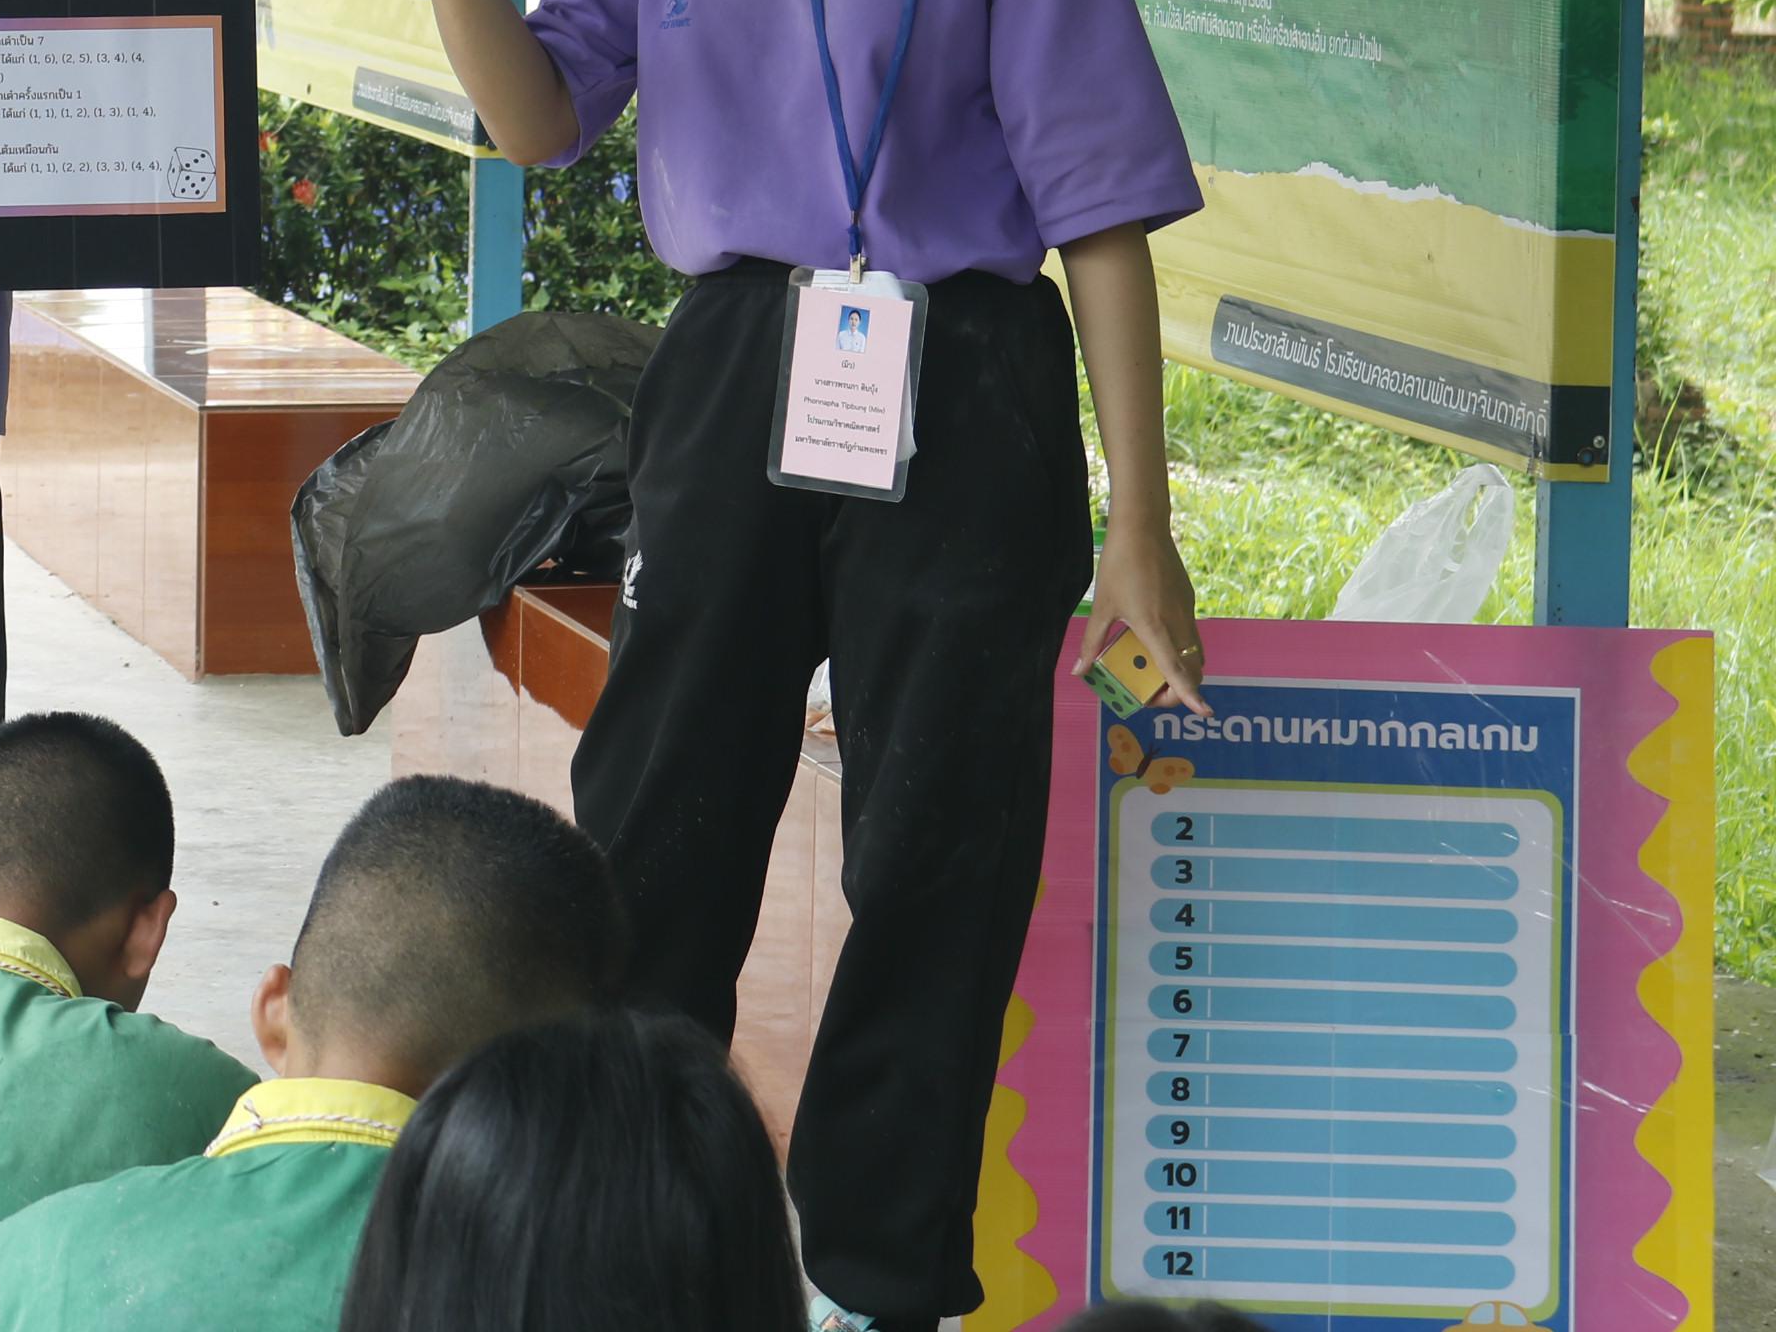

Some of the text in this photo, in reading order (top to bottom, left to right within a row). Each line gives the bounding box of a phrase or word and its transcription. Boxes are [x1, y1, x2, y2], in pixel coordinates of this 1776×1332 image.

[38, 36, 44, 45] 7
[1222, 319, 1322, 368] งานประชาสัมพันธ์
[1153, 710, 1538, 752] กระดานหมากกลเกม
[1176, 815, 1194, 840] 2
[1175, 860, 1193, 884] 3
[1175, 903, 1195, 927] 4
[1175, 946, 1193, 970] 5
[1173, 989, 1192, 1013] 6
[1173, 1034, 1190, 1057] 7
[1171, 1077, 1190, 1101] 8
[1171, 1121, 1190, 1145] 9
[1162, 1163, 1197, 1187] 10
[1166, 1206, 1190, 1230] 11
[1163, 1251, 1193, 1276] 12
